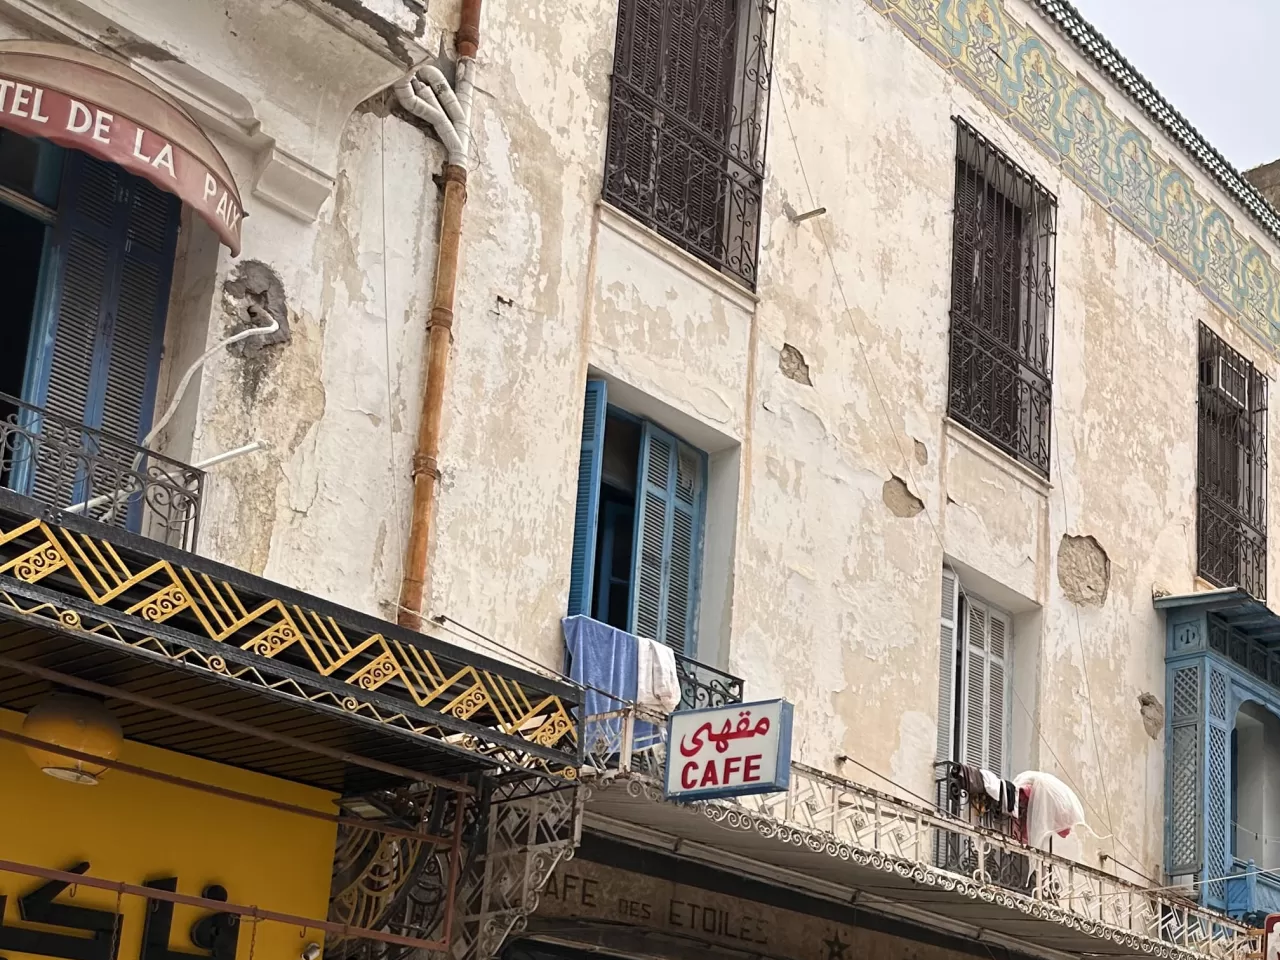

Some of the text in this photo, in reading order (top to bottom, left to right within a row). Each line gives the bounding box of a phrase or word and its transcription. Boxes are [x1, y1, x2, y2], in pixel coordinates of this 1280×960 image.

[66, 99, 114, 144] DE
[132, 128, 177, 180] LA
[203, 172, 241, 233] PAIX
[680, 710, 770, 757] مقهى
[681, 754, 762, 789] CAFE
[543, 872, 769, 944] AFE DES ETOILES
